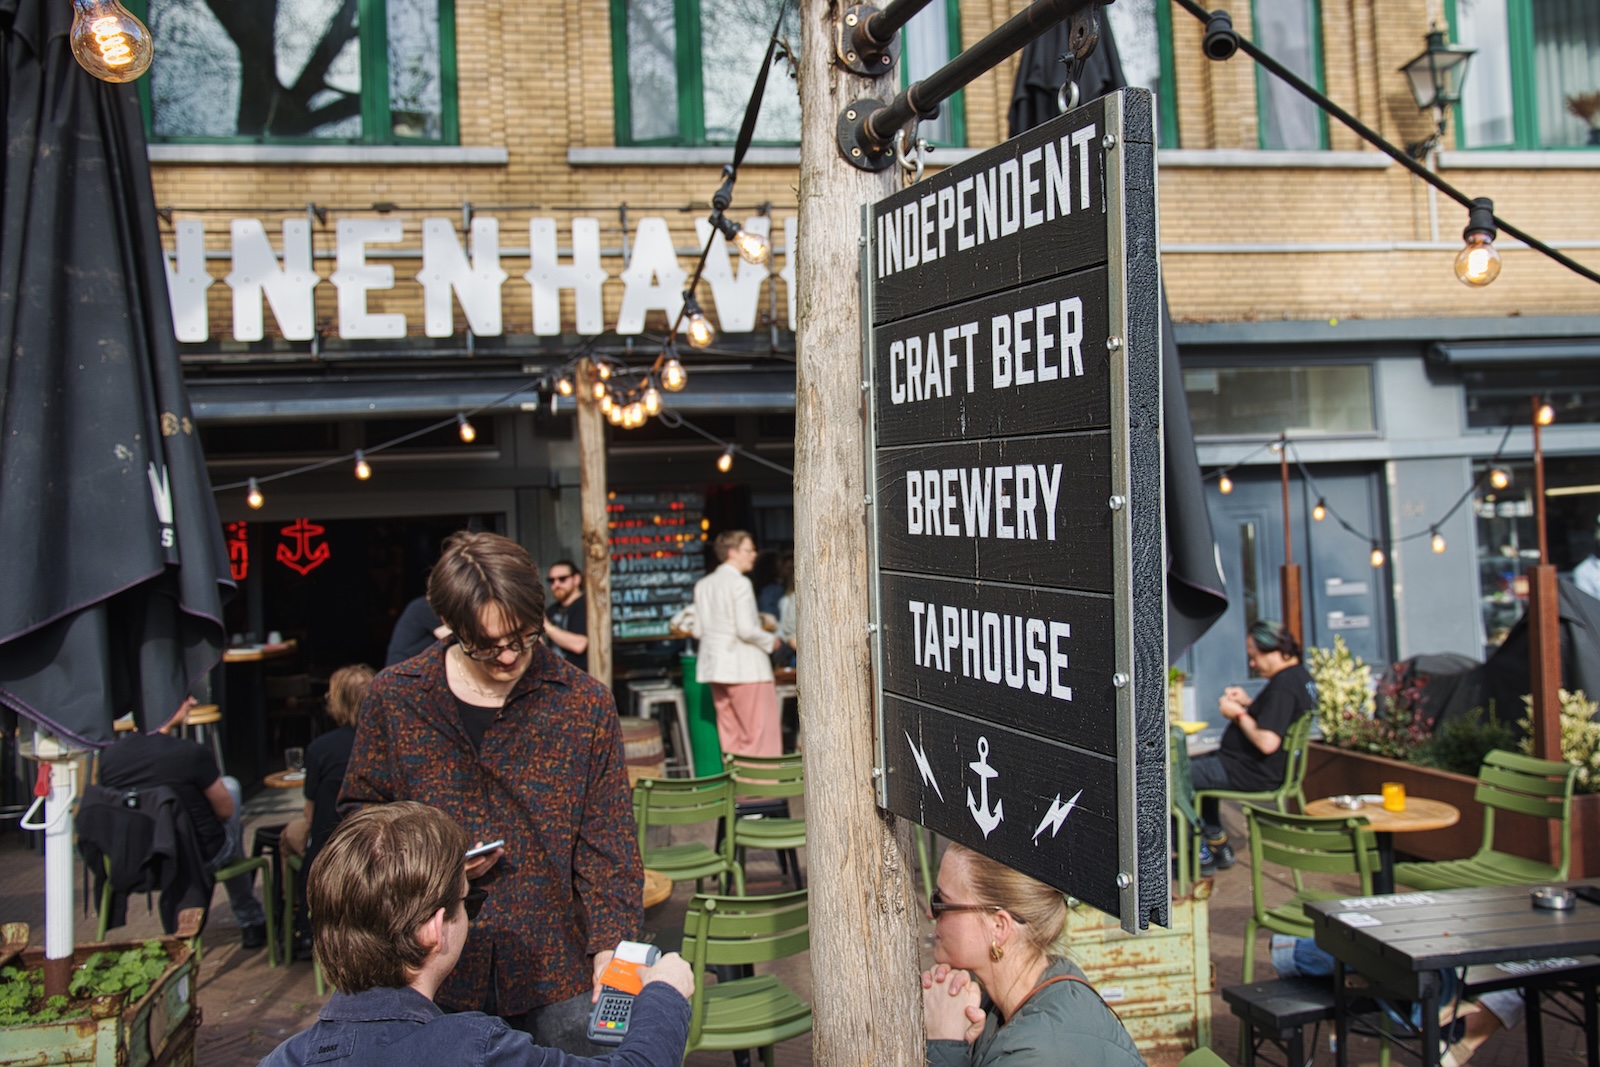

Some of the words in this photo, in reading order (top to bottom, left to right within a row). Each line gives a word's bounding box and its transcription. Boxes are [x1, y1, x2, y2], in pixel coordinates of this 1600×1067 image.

[877, 123, 1096, 279] INDEPENDENT
[163, 216, 797, 342] NENHAV
[889, 321, 979, 405] CRAFT
[991, 296, 1084, 389] BEER
[906, 463, 1062, 541] BREWERY
[908, 600, 1072, 702] TAPHOUSE
